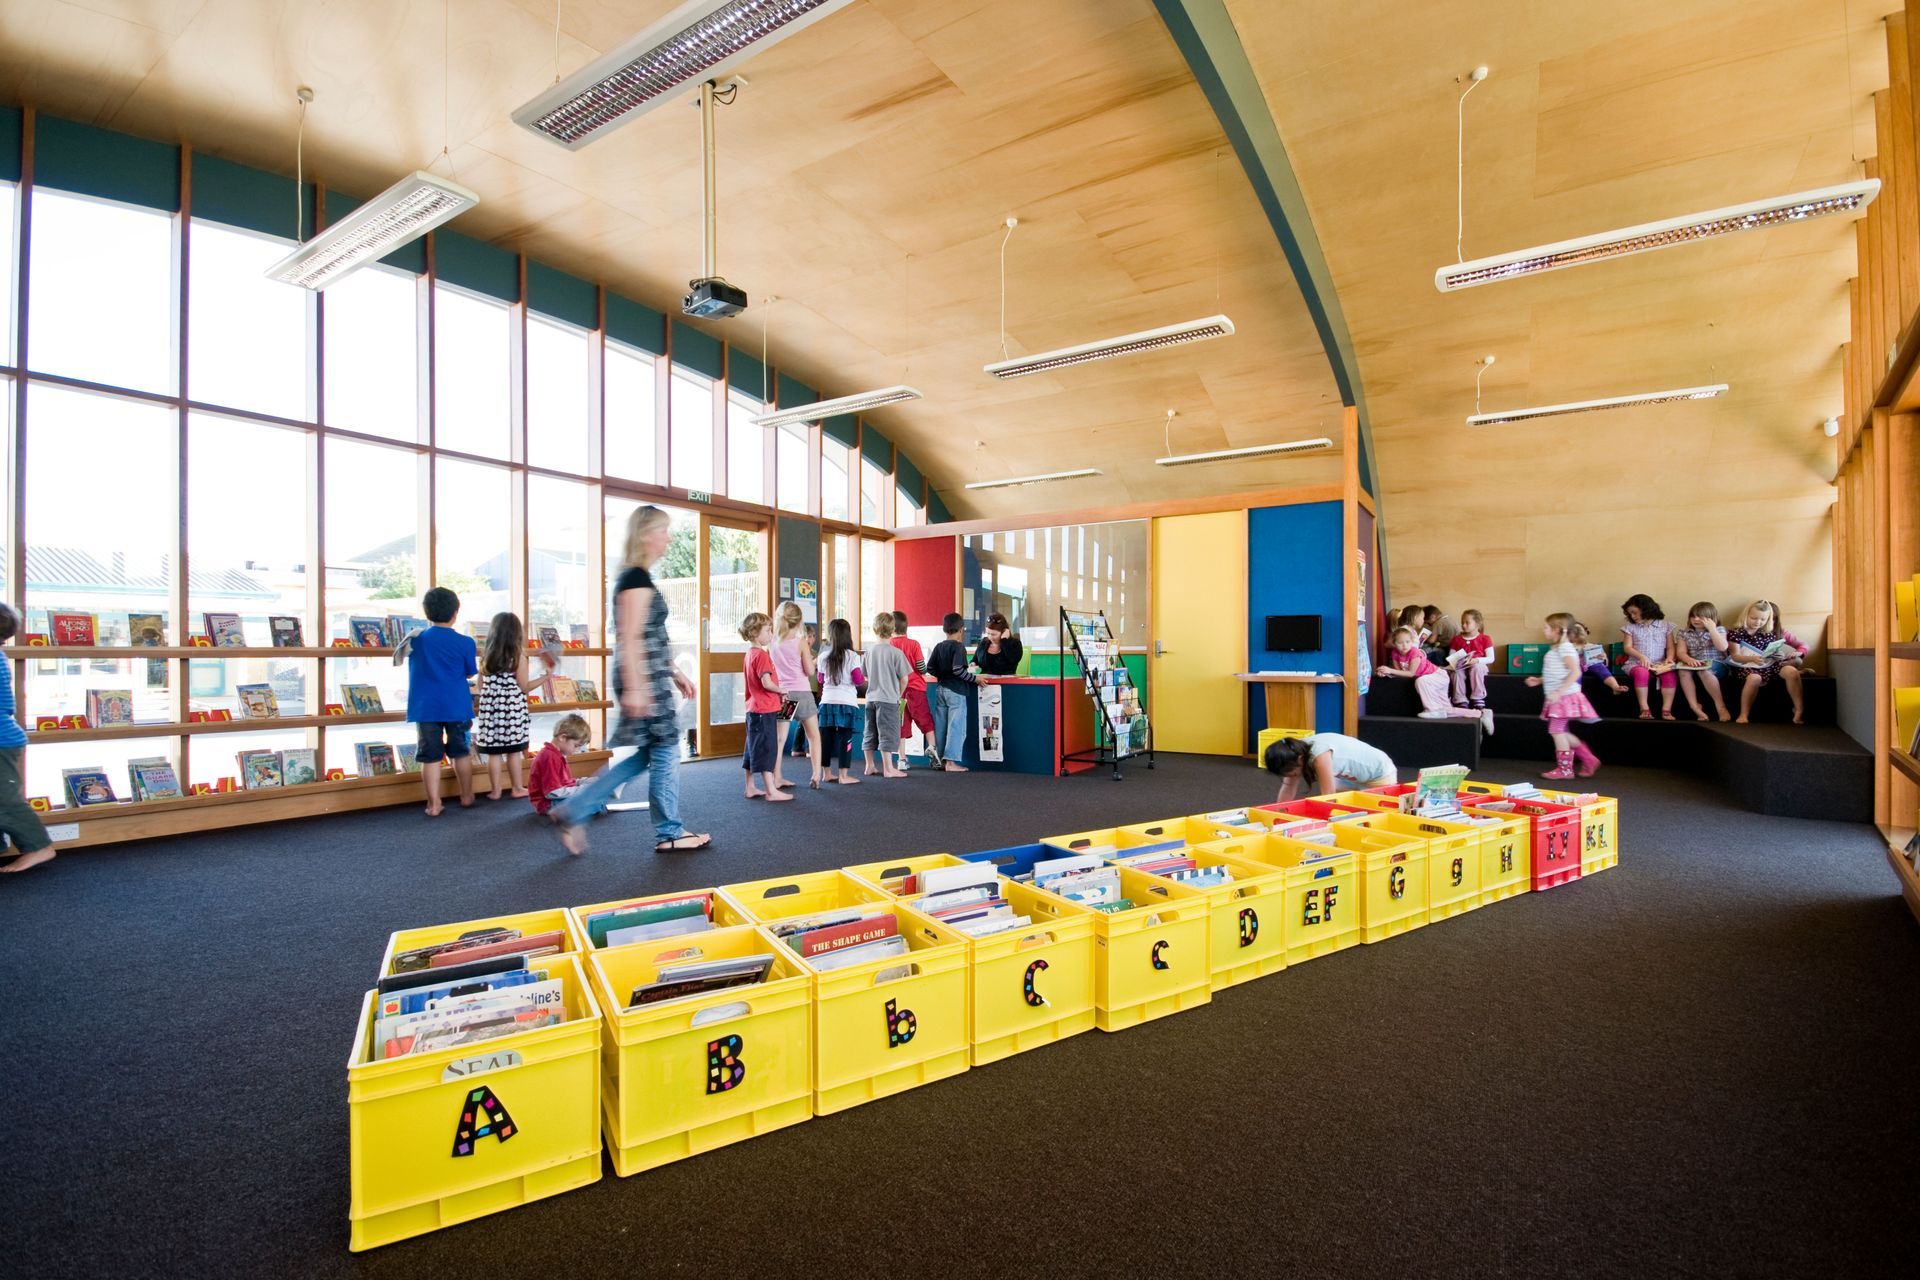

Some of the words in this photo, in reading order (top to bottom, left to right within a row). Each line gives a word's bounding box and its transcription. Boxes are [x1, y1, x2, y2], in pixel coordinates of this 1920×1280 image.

[690, 490, 711, 502] EXIT
[1586, 824, 1608, 851] KL
[1501, 843, 1513, 873] H
[1391, 866, 1405, 899] G
[1303, 886, 1338, 926] EF
[811, 941, 831, 953] THE
[832, 934, 861, 948] SHAPE
[863, 928, 886, 940] GAME
[1239, 908, 1259, 948] D
[884, 998, 917, 1049] b
[706, 1034, 745, 1095] B
[452, 1085, 519, 1158] A
